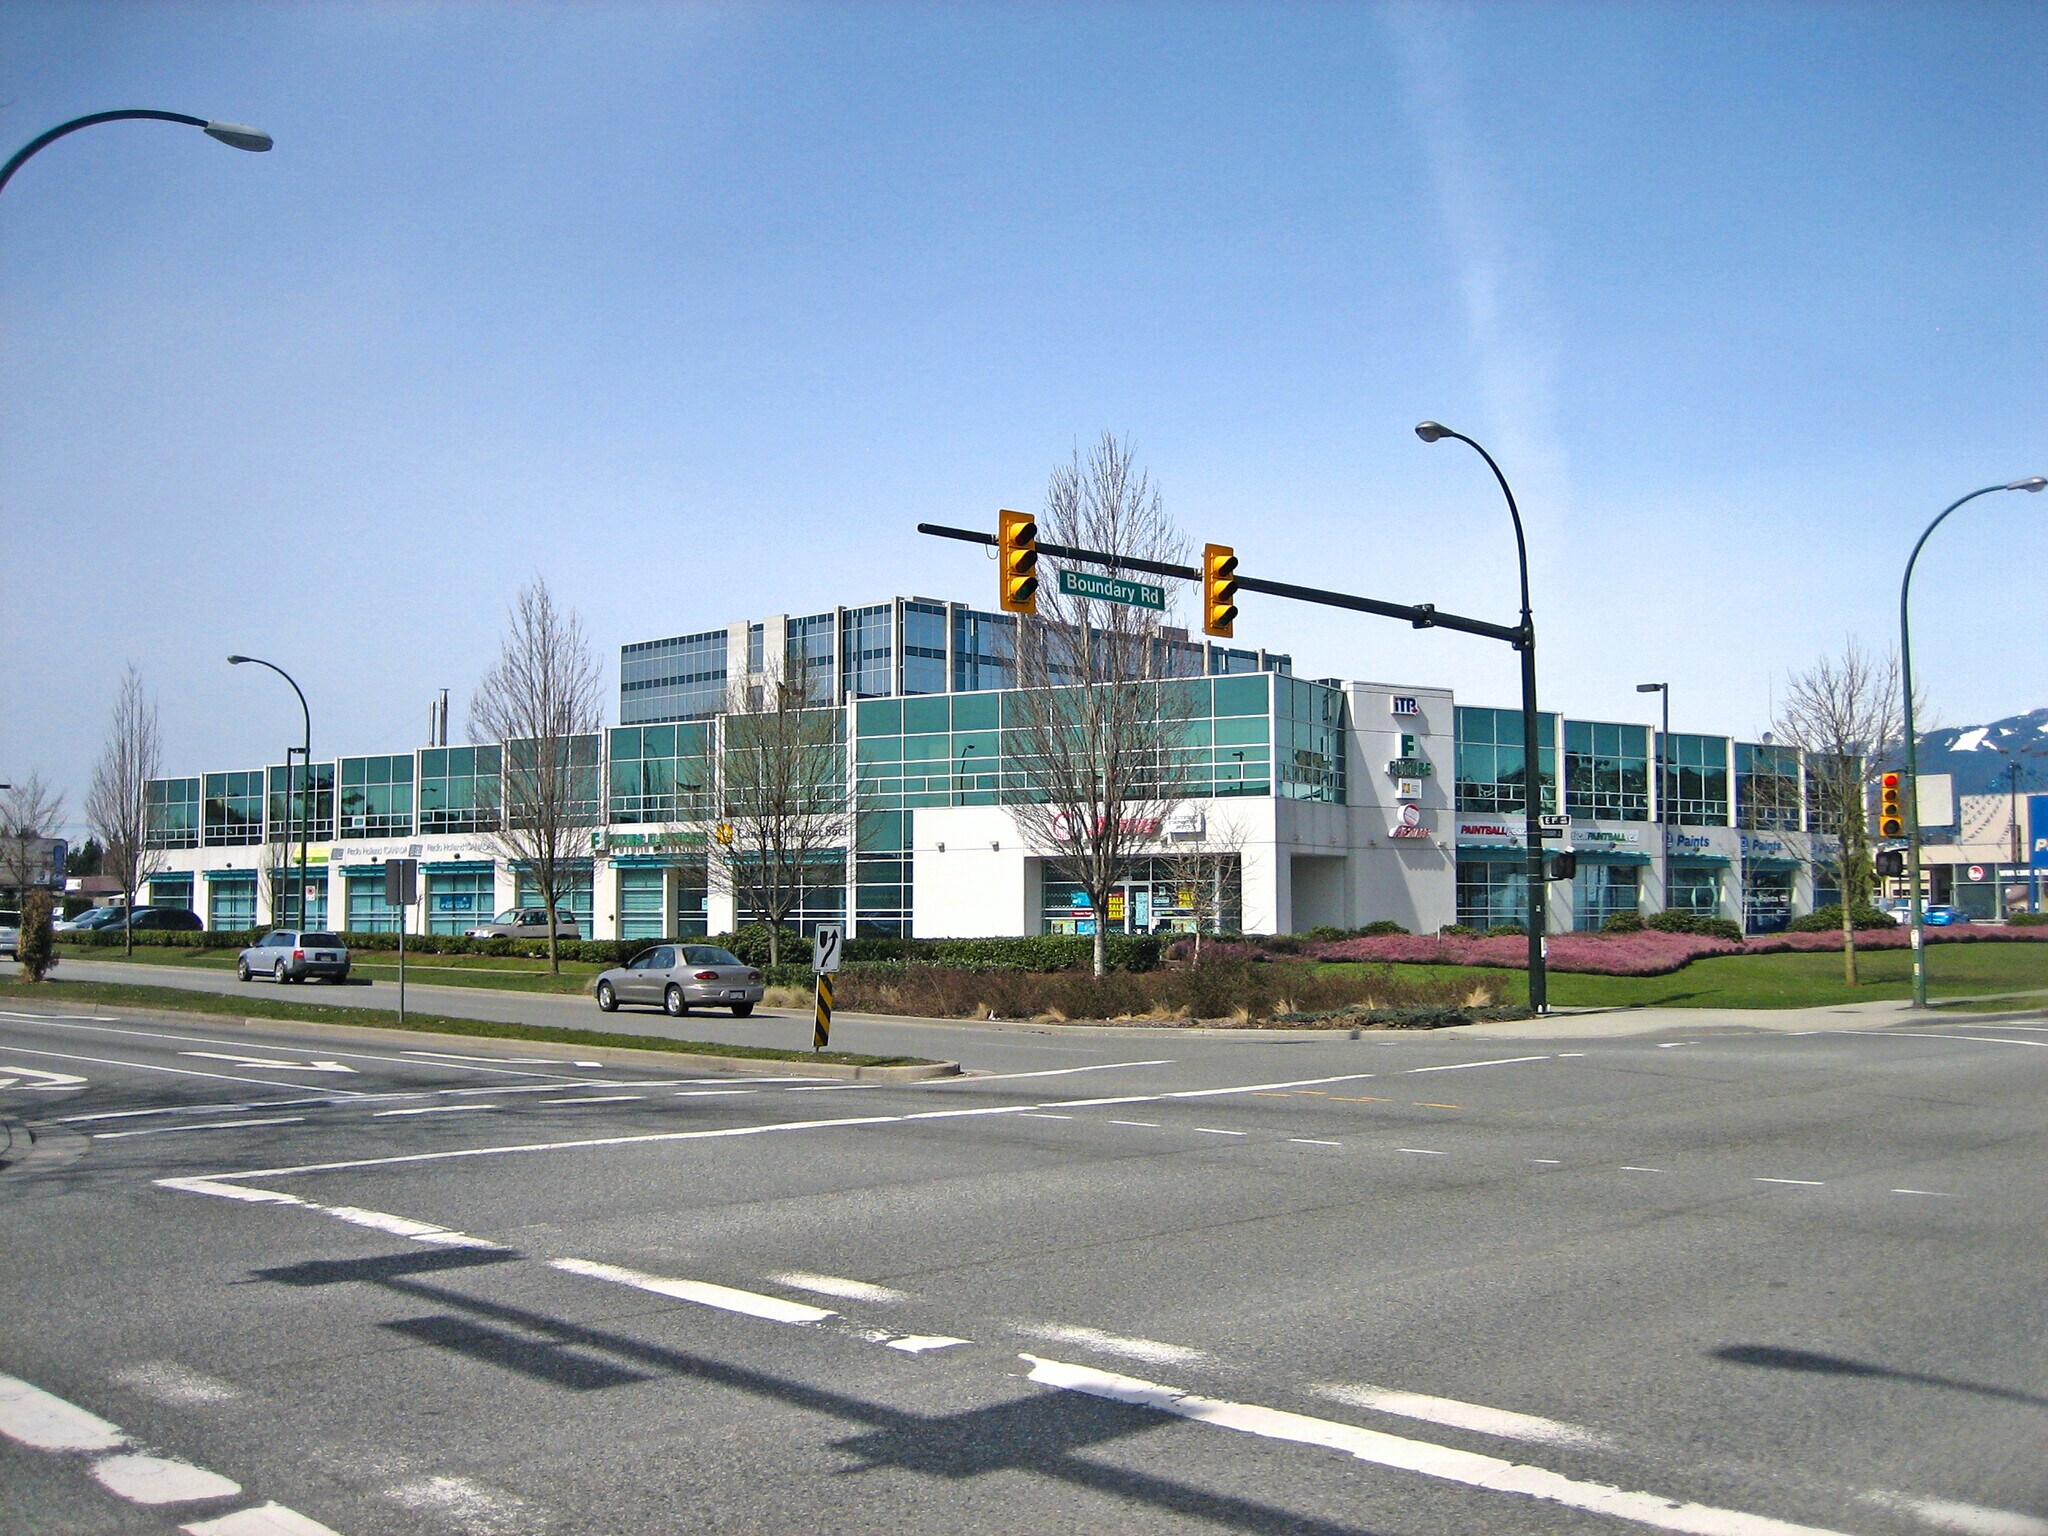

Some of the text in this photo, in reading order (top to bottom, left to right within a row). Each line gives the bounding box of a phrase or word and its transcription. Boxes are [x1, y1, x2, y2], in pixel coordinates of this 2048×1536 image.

[1066, 573, 1159, 605] Boundary Rd
[1461, 825, 1507, 836] PAINTBALL
[1677, 835, 1710, 848] Paints
[1752, 840, 1782, 851] Paints
[2034, 838, 2048, 852] P
